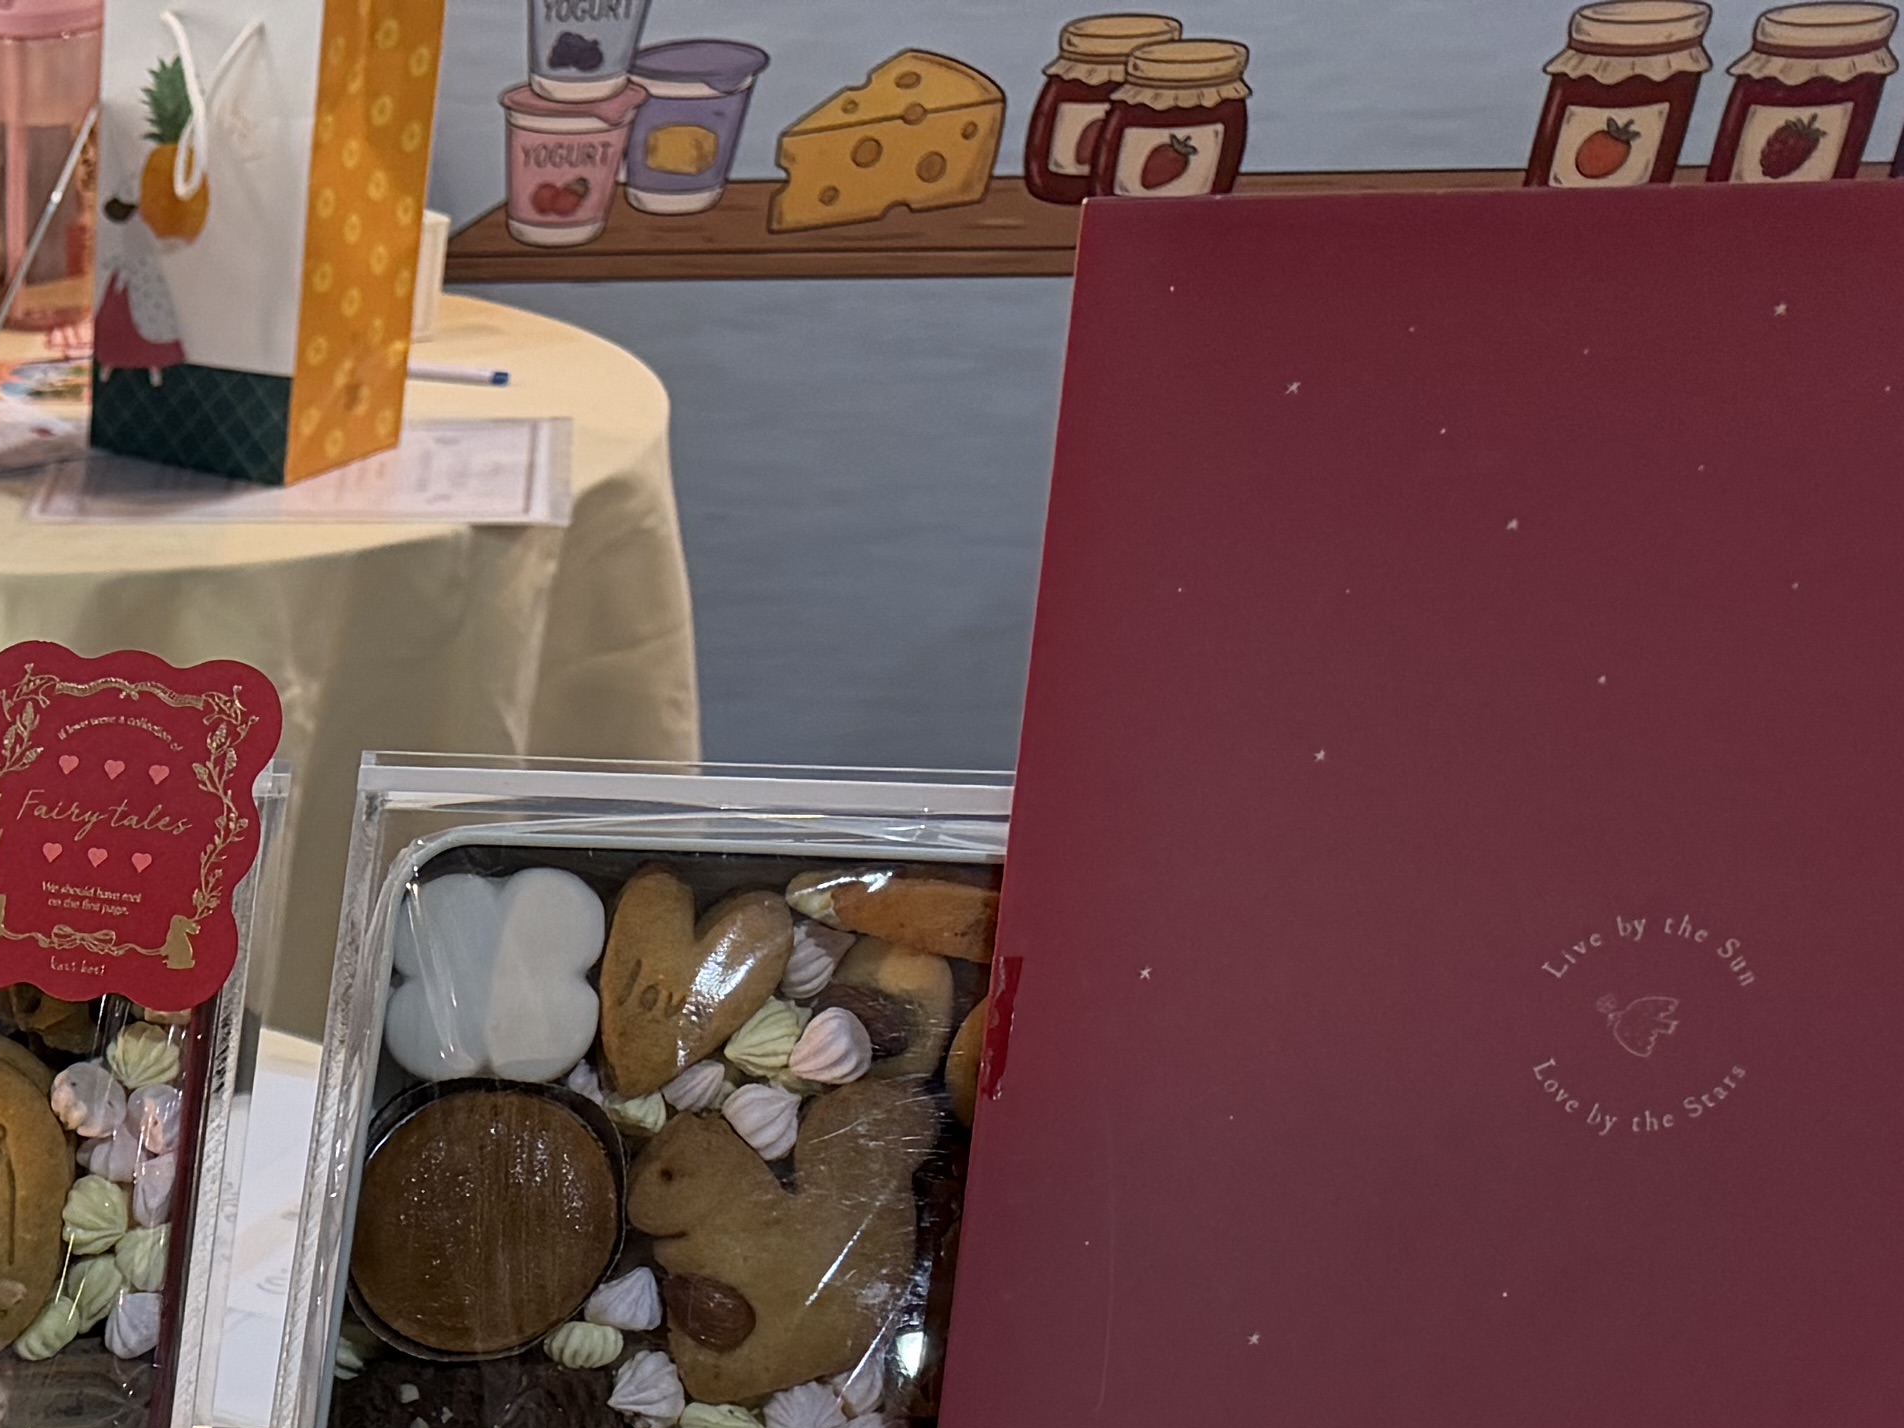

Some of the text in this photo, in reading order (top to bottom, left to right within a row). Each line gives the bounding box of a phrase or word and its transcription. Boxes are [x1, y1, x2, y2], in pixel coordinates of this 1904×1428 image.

[521, 141, 613, 169] YOGURT
[61, 883, 95, 898] should
[63, 898, 80, 909] the
[1542, 914, 1756, 987] Live by the Sun
[1532, 1057, 1747, 1137] Love by the Stars
